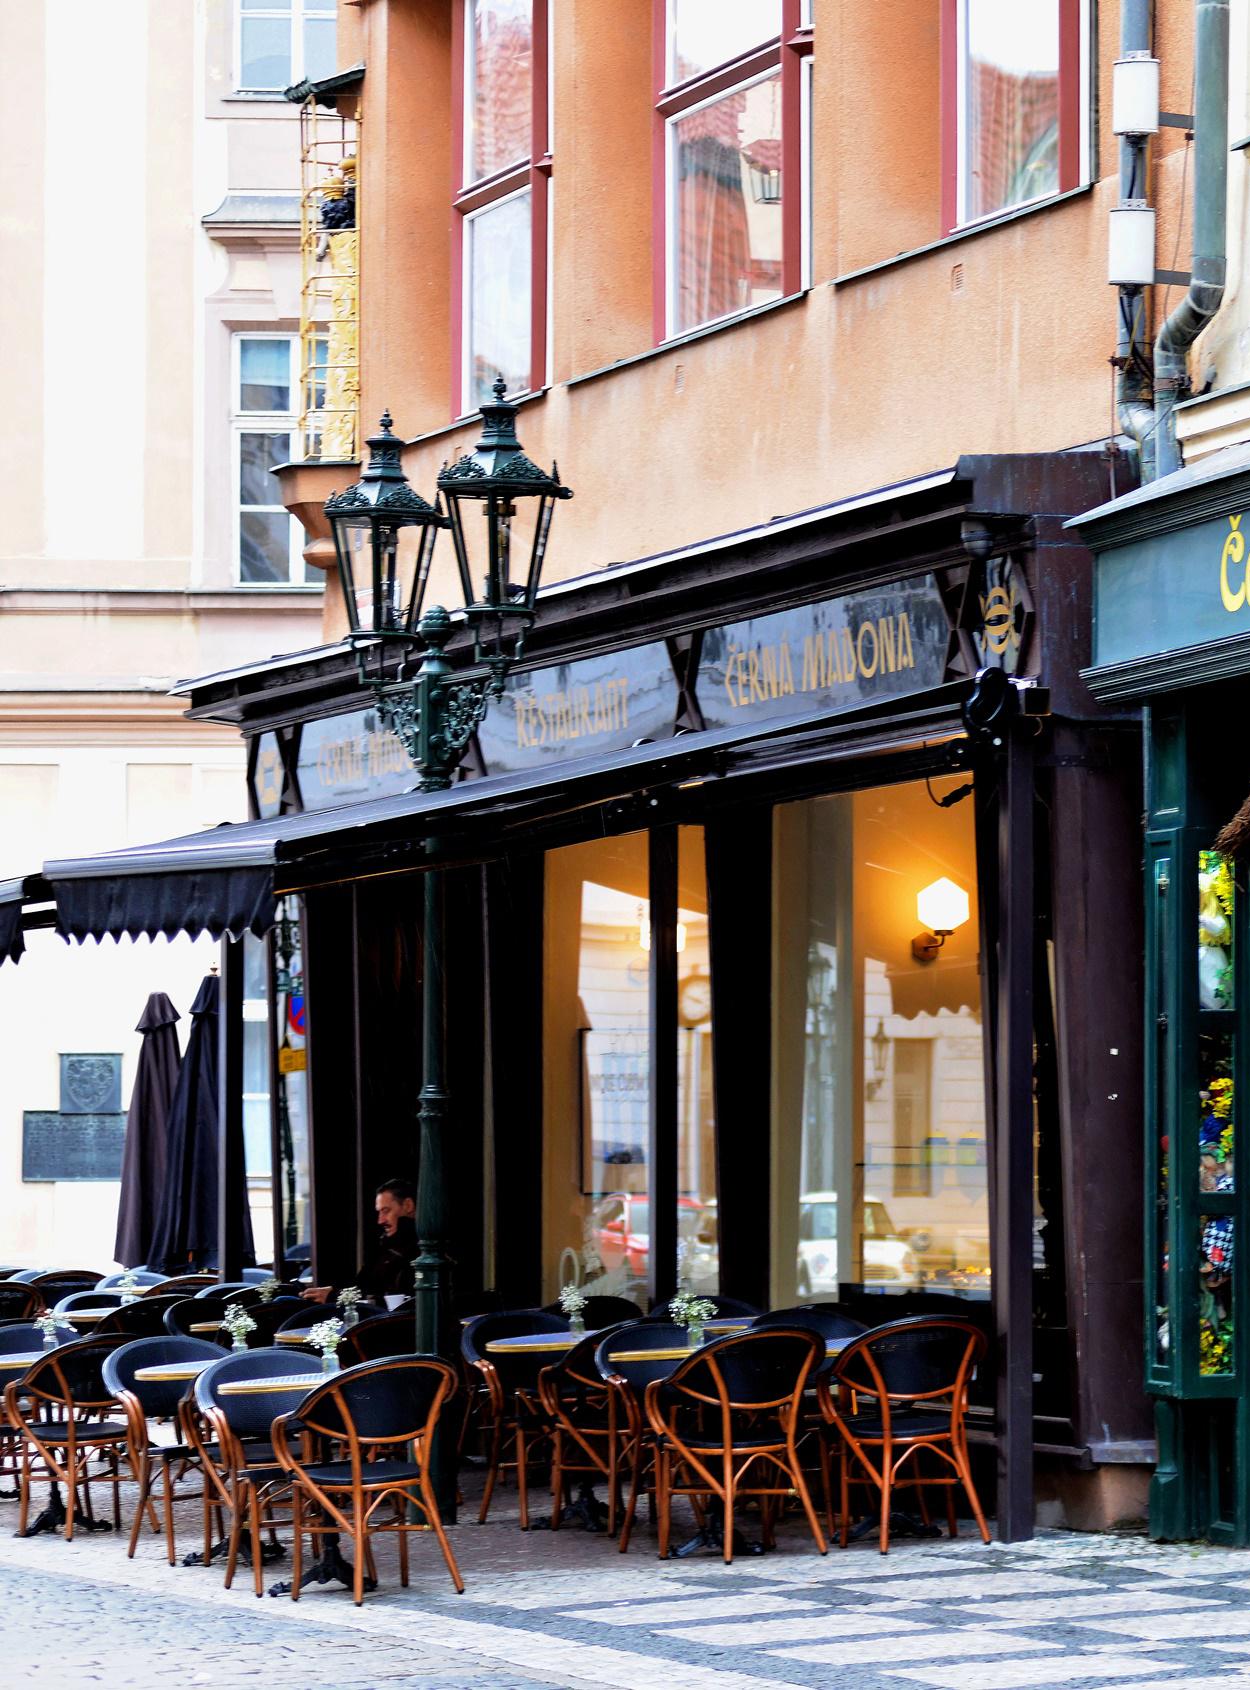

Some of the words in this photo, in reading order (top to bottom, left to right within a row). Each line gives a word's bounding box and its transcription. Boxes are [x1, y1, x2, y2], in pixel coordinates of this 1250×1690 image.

[725, 630, 795, 707] ČERNÁ
[802, 612, 915, 692] MADONA
[515, 677, 628, 749] RESTAURANT
